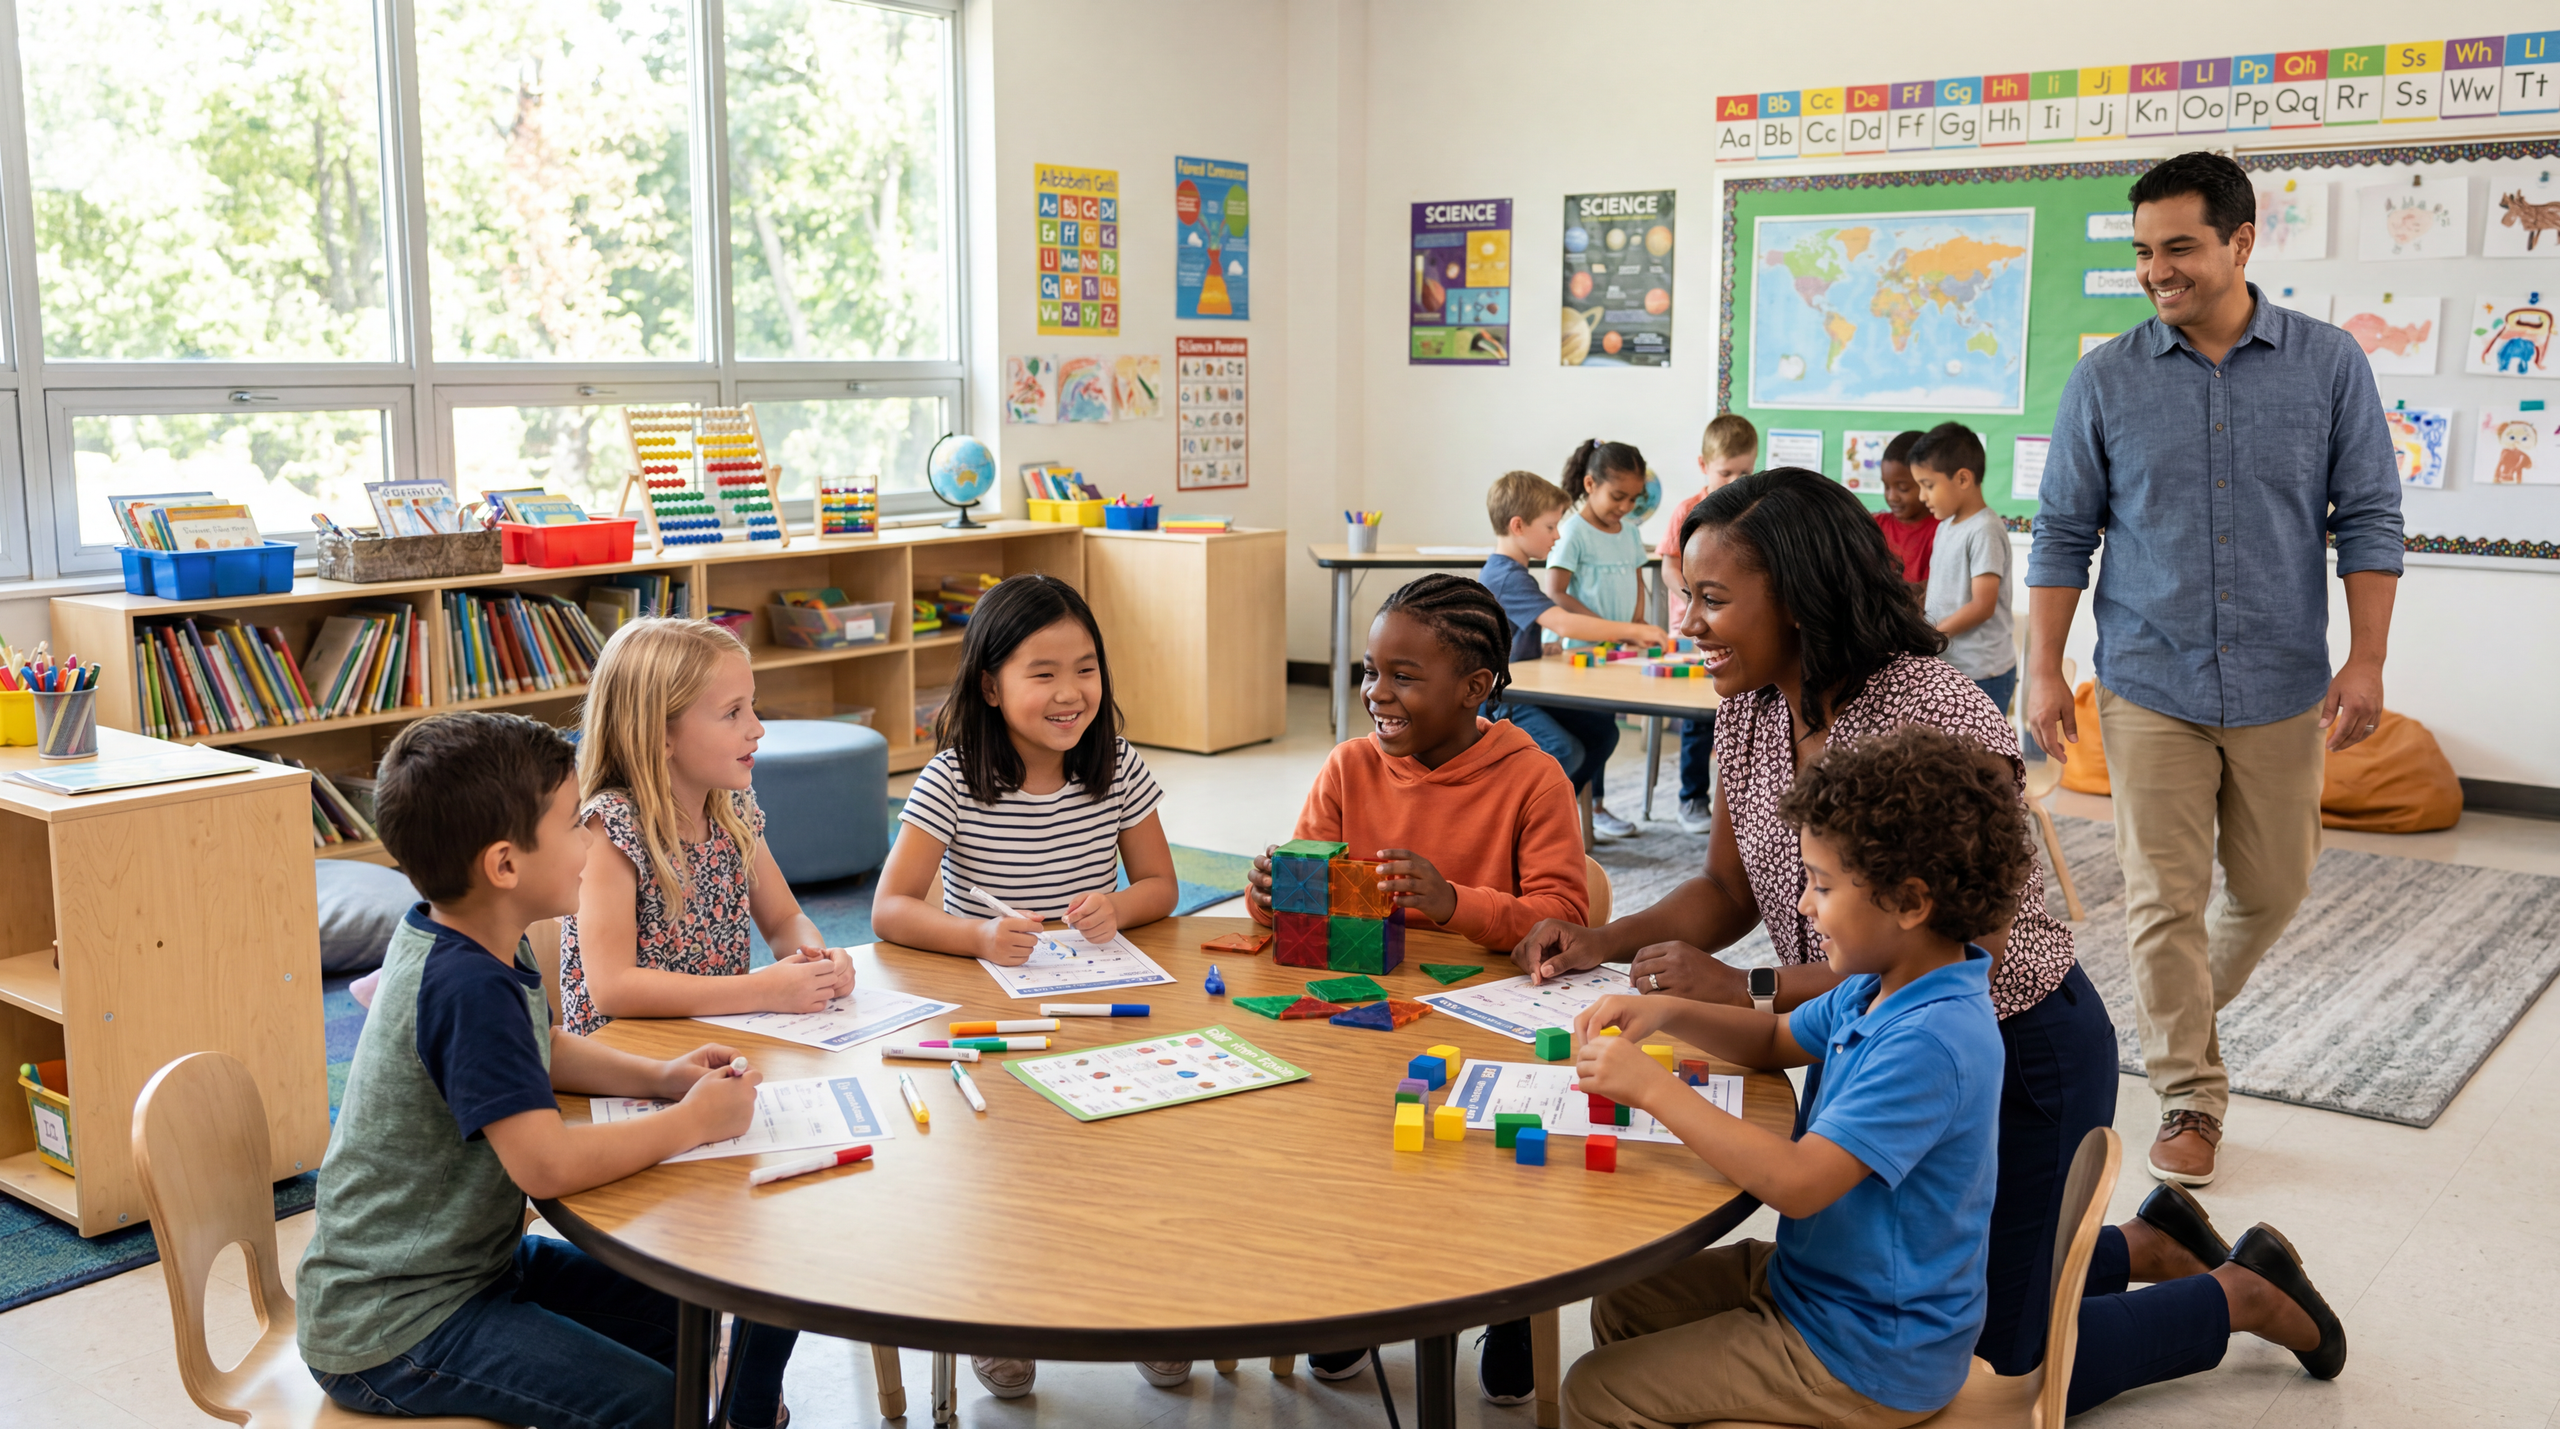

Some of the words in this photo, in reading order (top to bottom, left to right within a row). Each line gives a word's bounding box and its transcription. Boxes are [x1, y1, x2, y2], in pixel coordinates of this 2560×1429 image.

[1724, 100, 1748, 116] Aa
[1768, 95, 1791, 113] Bb
[1810, 93, 1833, 110] Cc
[1854, 90, 1879, 108] De
[1903, 85, 1922, 103] Ff
[1944, 83, 1972, 105] Gg
[1993, 78, 2018, 97] Hh
[2094, 70, 2112, 94] Jj
[2141, 67, 2166, 86] Kk
[2240, 60, 2268, 84] Pp
[2284, 55, 2316, 76] Qh
[2344, 53, 2368, 71] Rr
[2402, 48, 2426, 67] Ss
[2455, 41, 2492, 62] Wh
[1720, 128, 1750, 148] Aa
[1765, 123, 1792, 146] Bb
[1807, 121, 1836, 143] Cc
[1850, 117, 1881, 141] Dd
[1898, 113, 1925, 137] Ff
[1940, 113, 1975, 141] Gg
[1988, 108, 2020, 132] Hh
[2045, 105, 2060, 129] Ii
[2090, 103, 2112, 136] Jj
[2136, 99, 2167, 123] Kn
[2183, 96, 2223, 119] Oo
[2235, 92, 2268, 124] Pp
[2276, 89, 2320, 121] Qq
[2338, 85, 2368, 109] Rr
[2397, 81, 2426, 106] Ss
[2450, 78, 2494, 102] Ww
[2516, 72, 2548, 98] Tt
[1425, 204, 1496, 223] SCIENCE
[1580, 196, 1657, 215] SCIENCE
